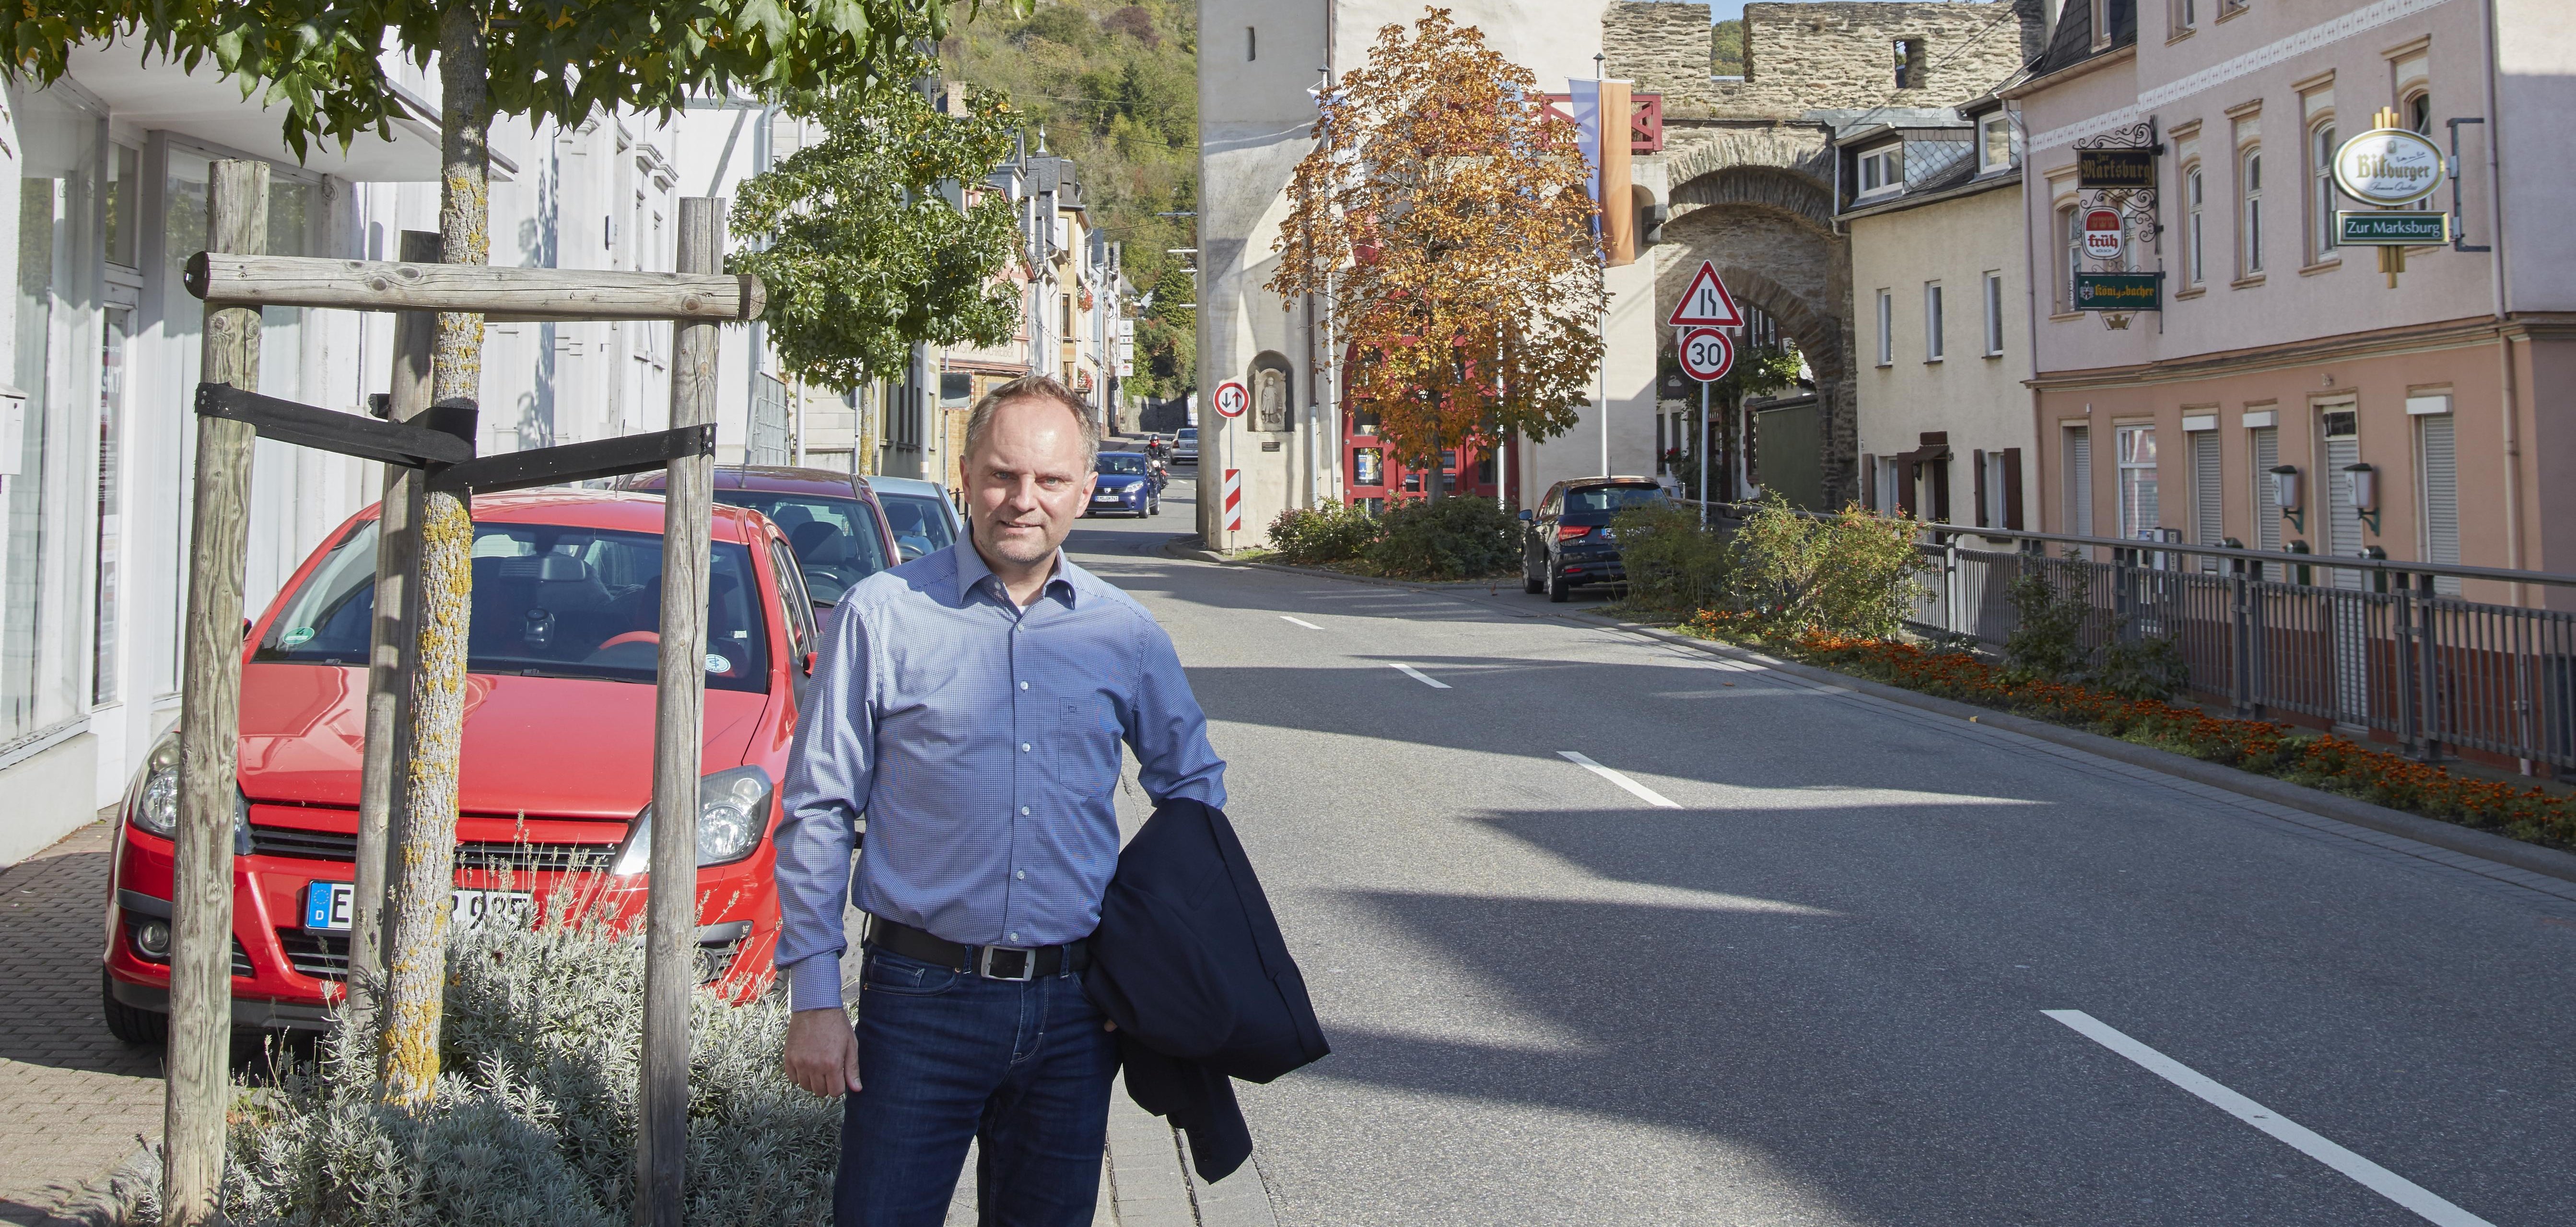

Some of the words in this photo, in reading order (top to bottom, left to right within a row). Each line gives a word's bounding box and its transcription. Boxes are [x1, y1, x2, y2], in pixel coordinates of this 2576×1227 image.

[2083, 160, 2152, 184] Marksburg
[2355, 153, 2430, 182] Bitburger
[2347, 222, 2370, 233] Zur
[2373, 221, 2440, 236] Marksburg
[2088, 234, 2118, 249] früh
[2095, 283, 2154, 299] Königsbacher
[1691, 342, 1721, 366] 30
[315, 910, 324, 920] D
